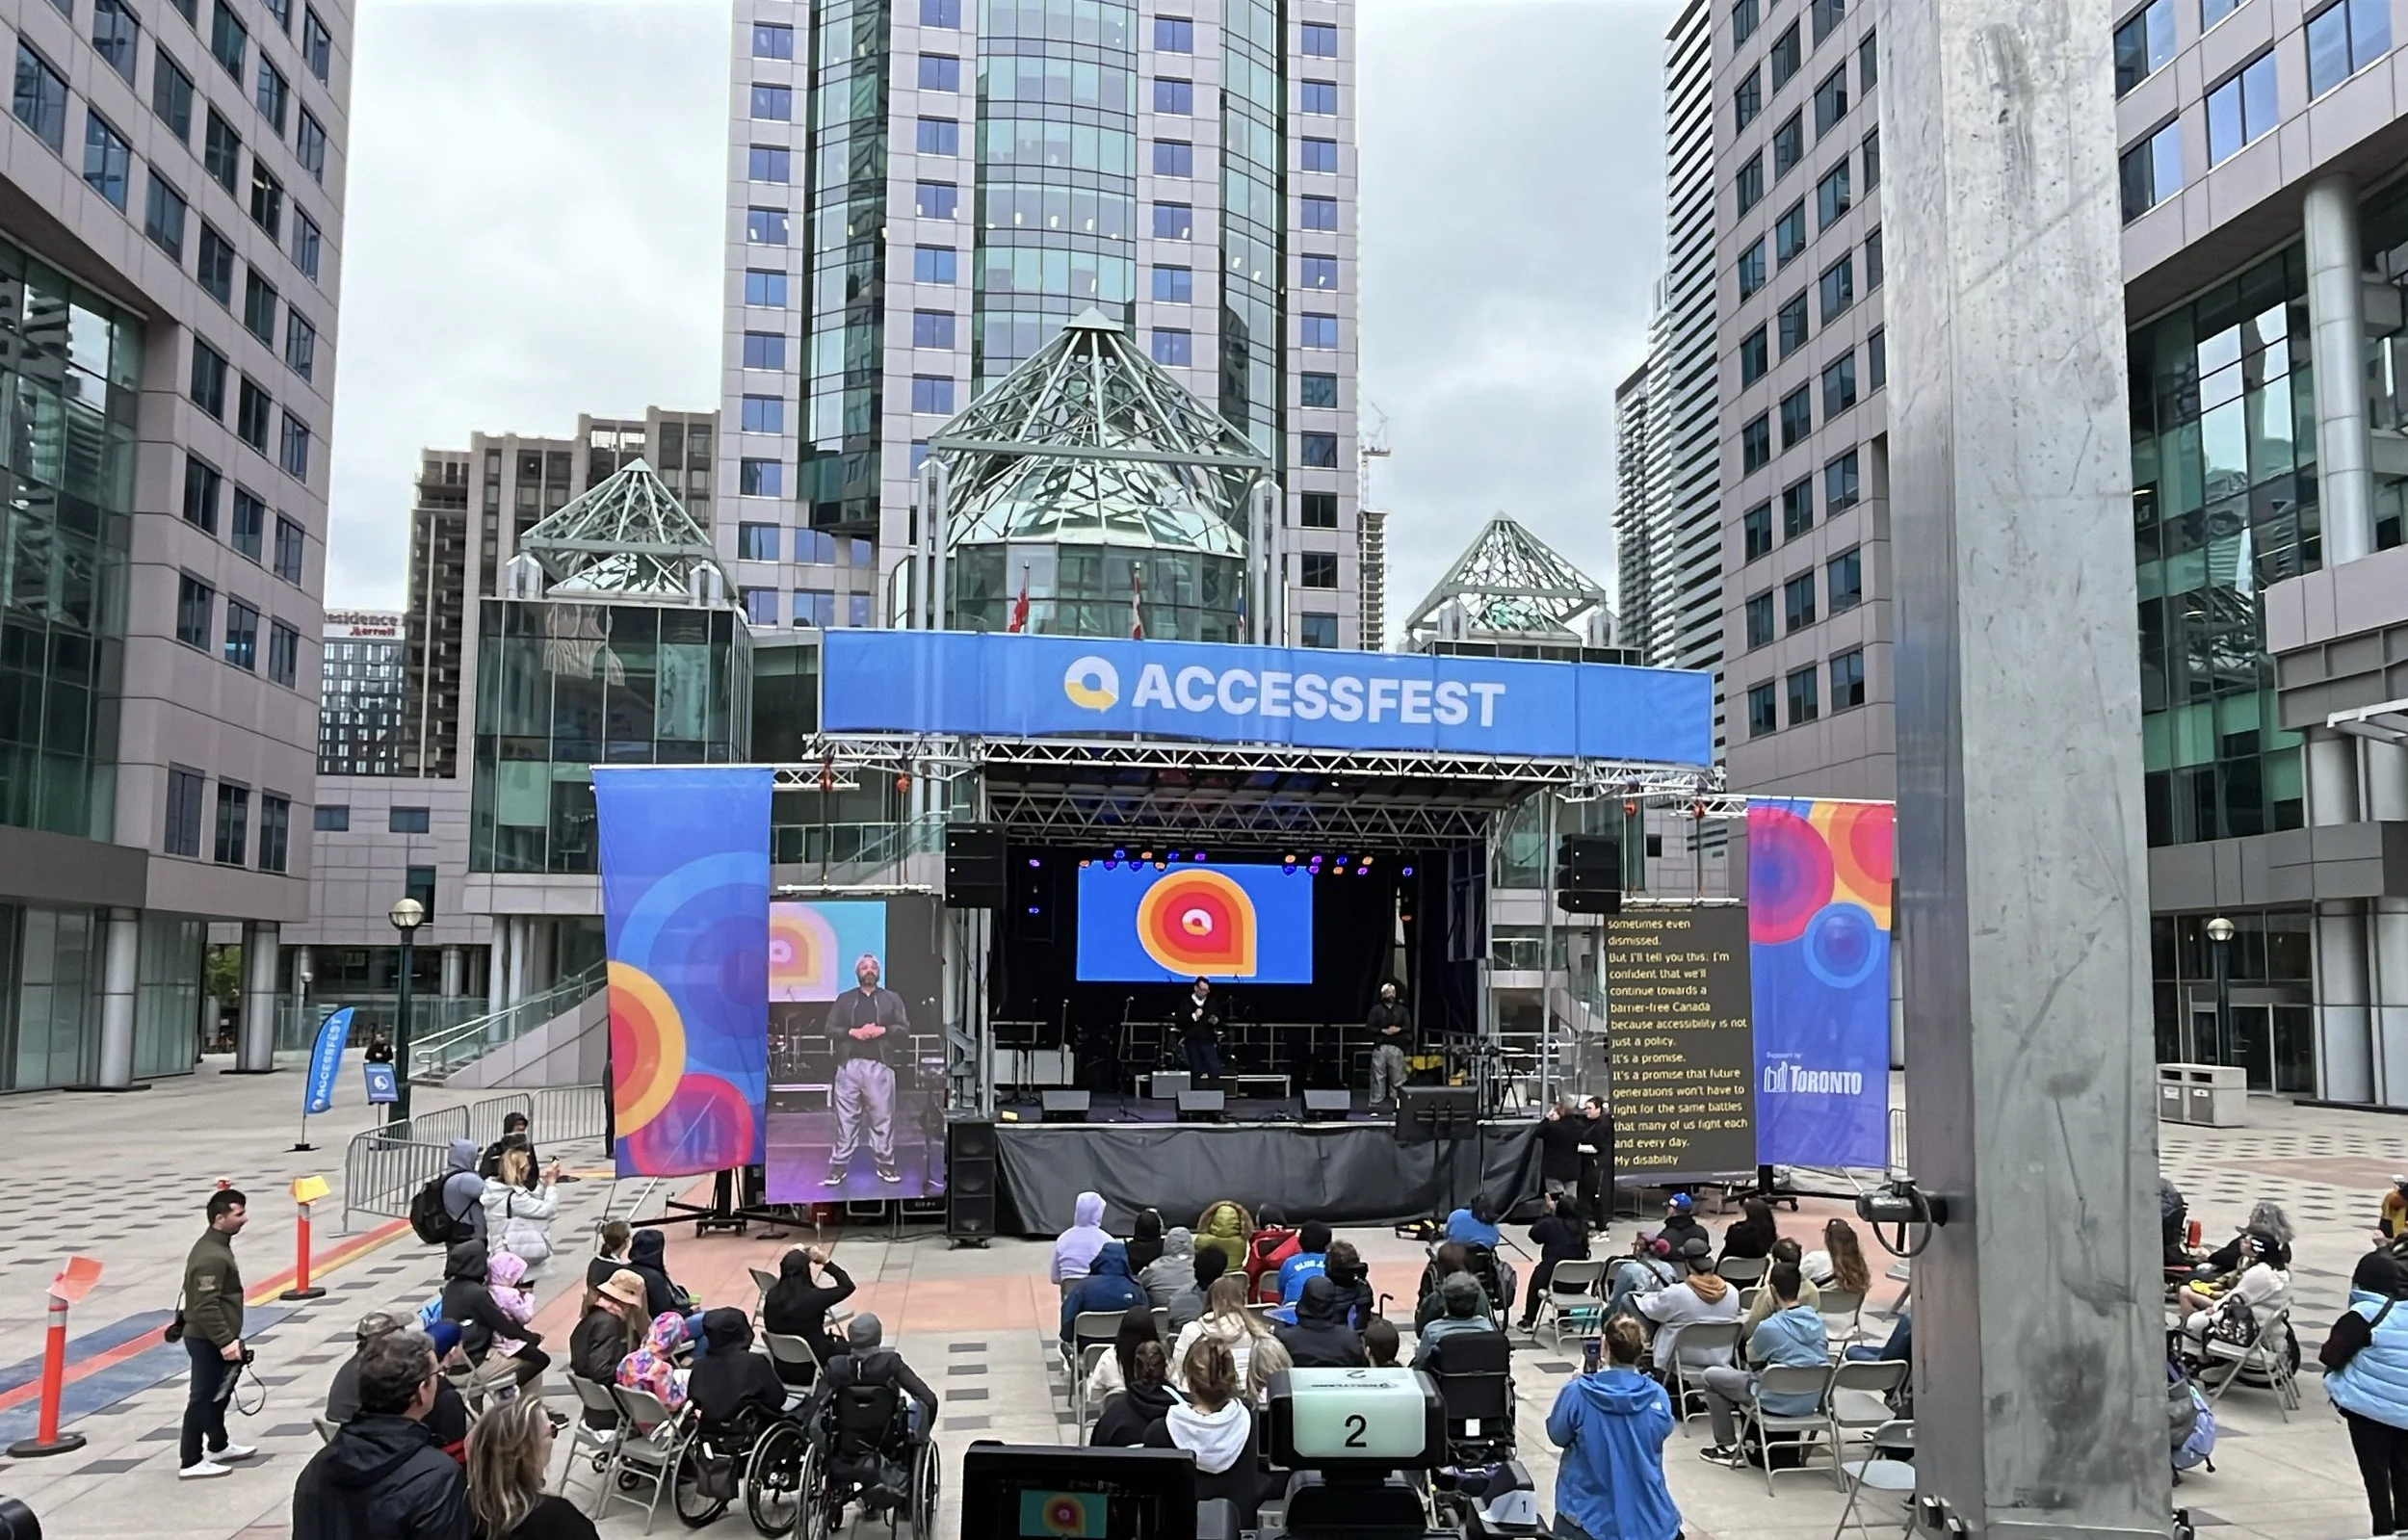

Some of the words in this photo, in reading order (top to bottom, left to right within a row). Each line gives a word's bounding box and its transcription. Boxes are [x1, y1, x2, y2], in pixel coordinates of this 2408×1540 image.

[1131, 663, 1505, 727] ACCESSFEST
[1608, 920, 1662, 929] sometimes
[1666, 920, 1690, 928] even
[1609, 936, 1662, 946] dismissed.
[1610, 953, 1627, 962] But
[1631, 953, 1642, 962] I'll
[1646, 953, 1662, 962] tell
[1665, 953, 1683, 963] you
[1714, 952, 1729, 961] I'm
[1610, 969, 1657, 979] confident
[1660, 969, 1680, 979] that
[1684, 969, 1706, 979] we'll
[1610, 986, 1654, 996] continue
[1658, 985, 1697, 995] towards
[1701, 986, 1707, 995] a
[1611, 1003, 1669, 1013] barrier-free
[1672, 1003, 1711, 1011] Canada
[1611, 1020, 1653, 1030] because
[1656, 1019, 1715, 1030] accessibility
[1719, 1019, 1728, 1028] is
[1731, 1019, 1747, 1028] not
[1611, 1037, 1631, 1048] just
[1644, 1036, 1676, 1047] policy.
[1612, 1055, 1629, 1064] It's
[1641, 1054, 1686, 1063] promise.
[1613, 1071, 1629, 1081] It's
[1642, 1070, 1683, 1081] promise
[1687, 1069, 1707, 1079] that
[1710, 1068, 1741, 1078] future
[1790, 1065, 1862, 1095] TORONTO
[1613, 1087, 1673, 1099] generations
[1677, 1086, 1704, 1096] won't
[1708, 1085, 1731, 1095] have
[1734, 1085, 1744, 1094] to
[1613, 1105, 1636, 1115] fight
[1640, 1104, 1654, 1113] for
[1658, 1104, 1674, 1113] the
[1678, 1104, 1705, 1112] same
[1708, 1102, 1742, 1111] battles
[1614, 1122, 1635, 1132] that
[1638, 1122, 1666, 1132] many
[1670, 1120, 1680, 1130] of
[1699, 1119, 1721, 1131] fight
[1724, 1119, 1747, 1128] each
[1615, 1138, 1634, 1148] and
[1637, 1139, 1665, 1148] every
[1669, 1137, 1689, 1148] day.
[1614, 1156, 1630, 1166] My
[1633, 1155, 1679, 1165] disability
[1345, 1414, 1367, 1448] 2
[1521, 1500, 1527, 1514] 1
